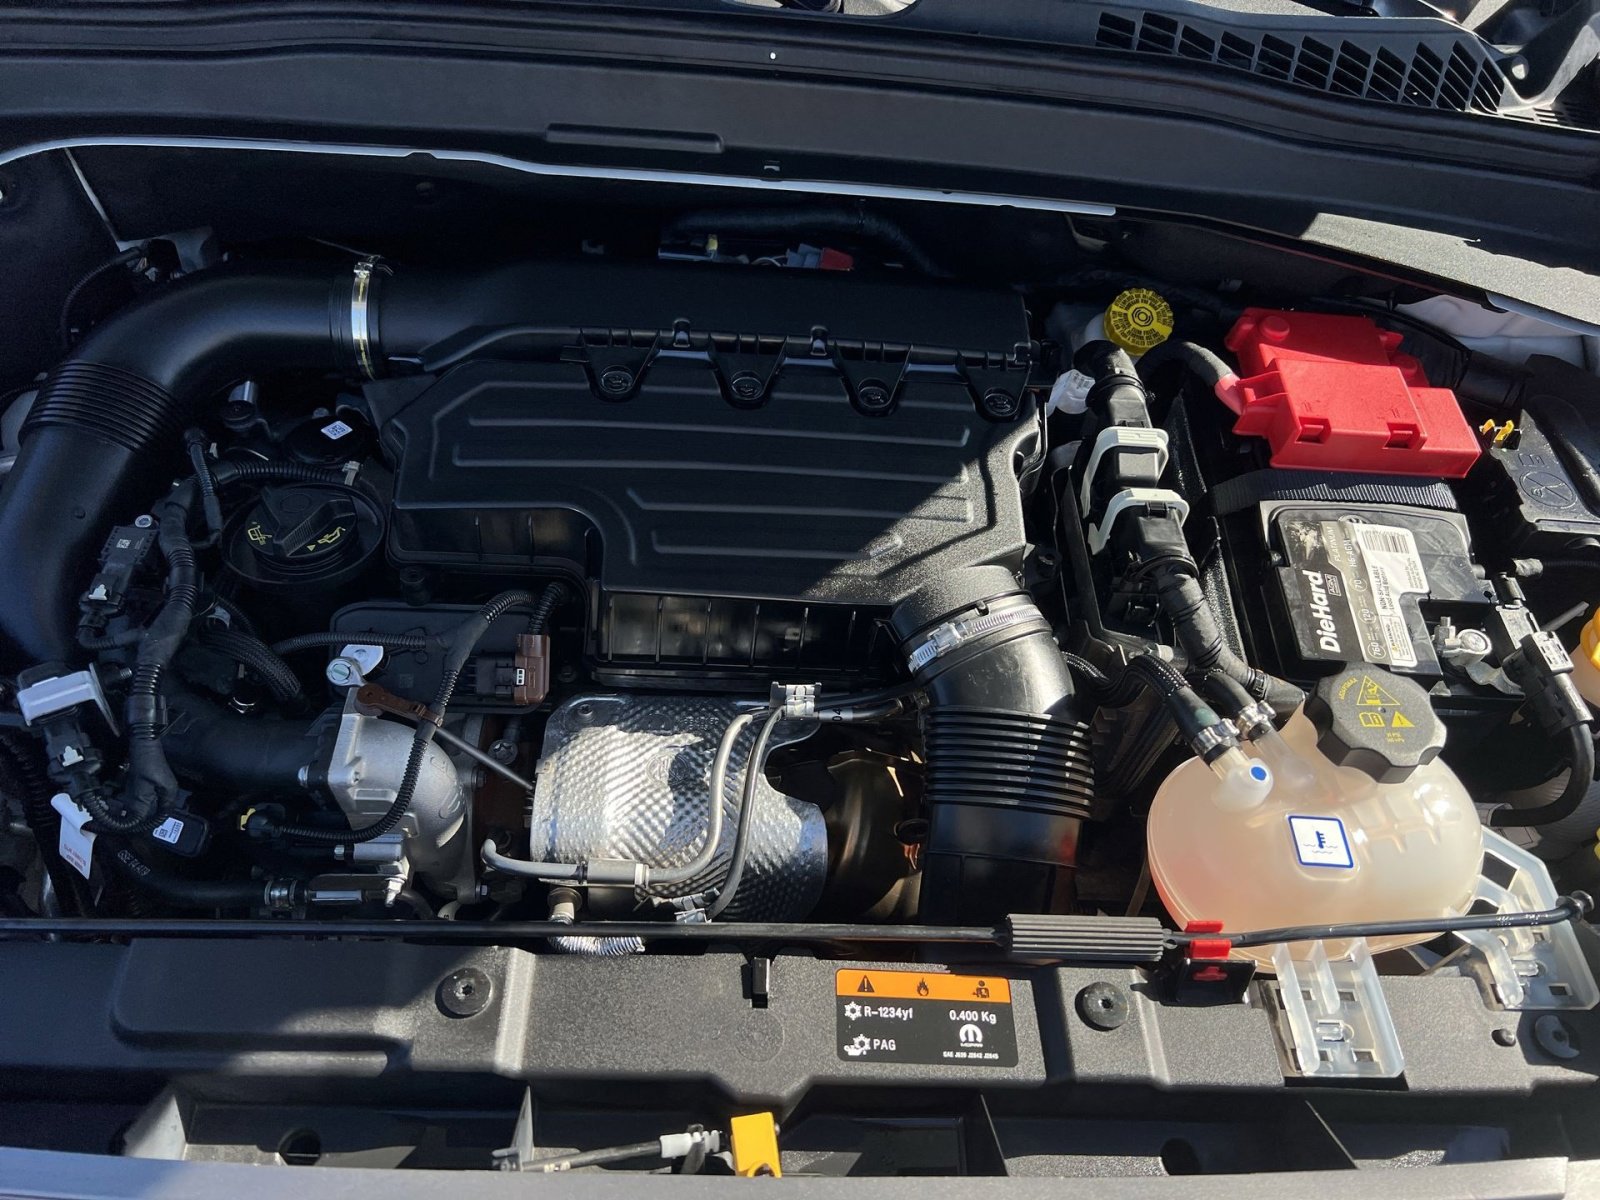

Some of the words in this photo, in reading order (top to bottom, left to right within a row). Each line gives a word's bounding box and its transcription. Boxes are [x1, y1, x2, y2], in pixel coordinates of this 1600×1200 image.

[1302, 570, 1341, 653] DieHard
[1370, 642, 1382, 656] 760
[864, 1006, 913, 1021] R-1234yf
[950, 1010, 978, 1021] 0.400
[981, 1012, 997, 1024] Kg
[873, 1038, 896, 1051] PAG
